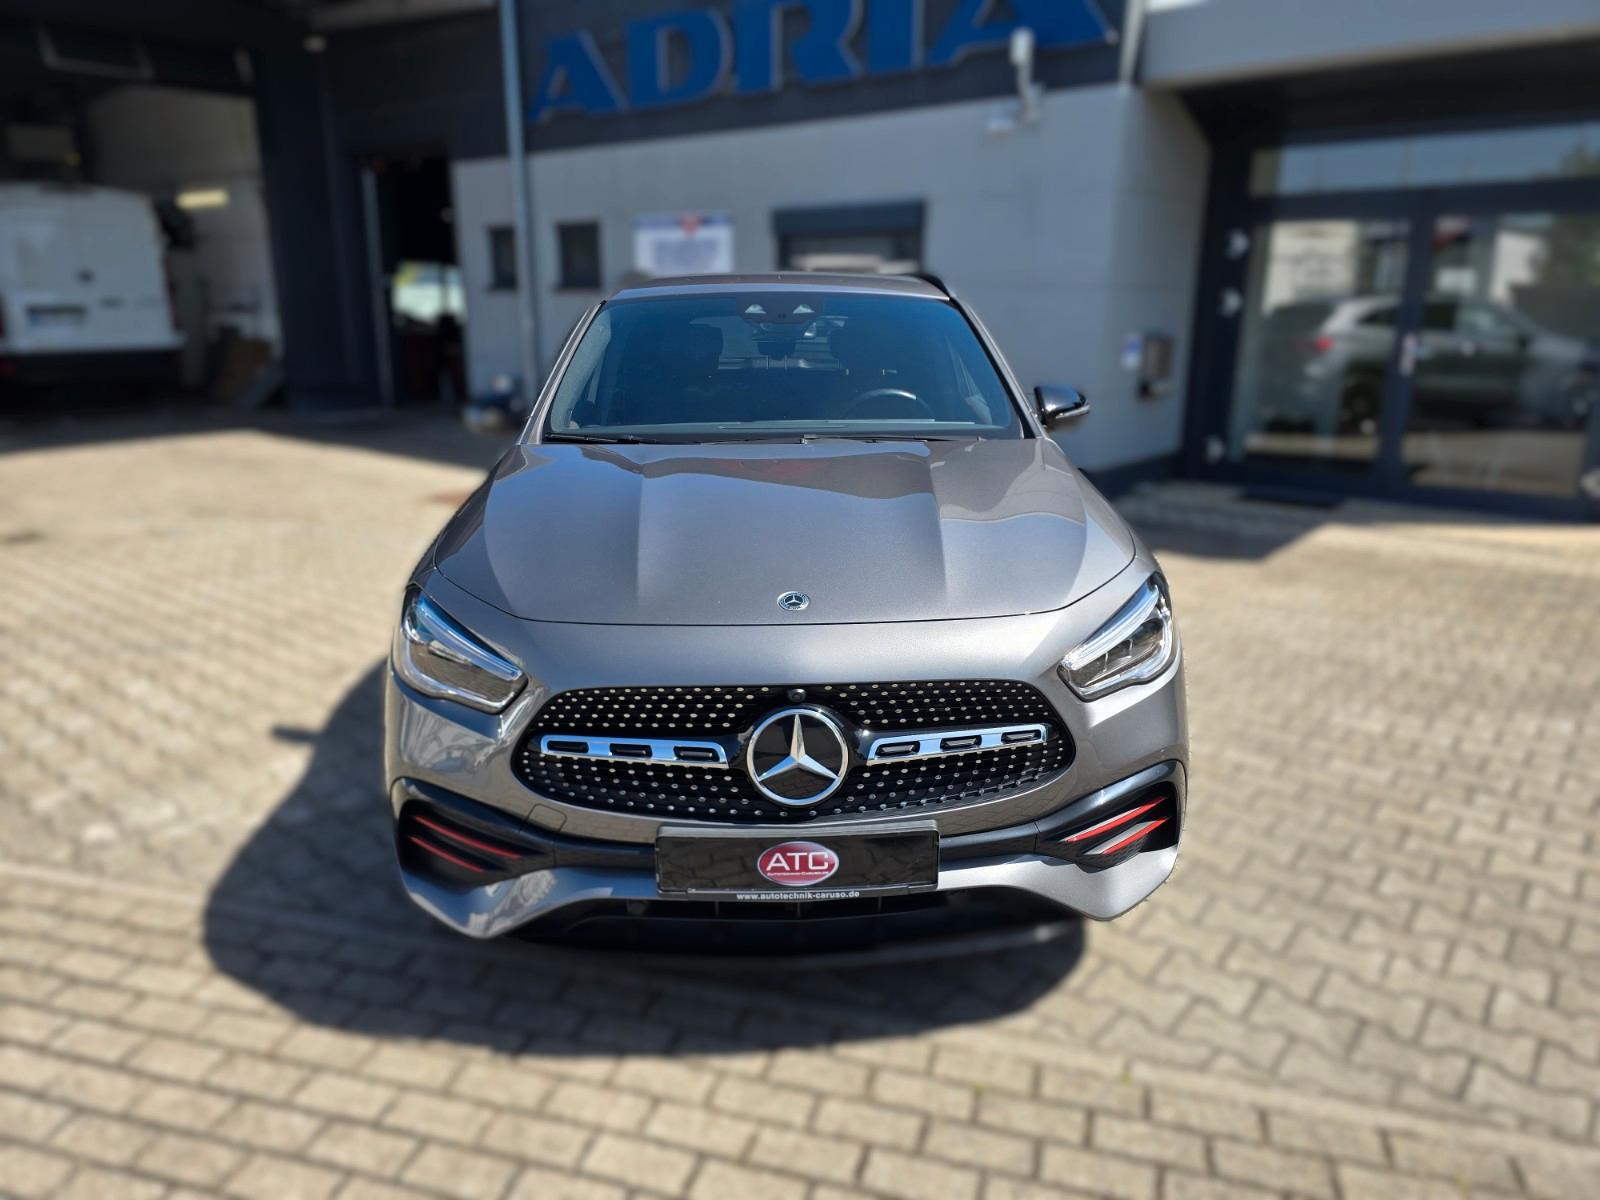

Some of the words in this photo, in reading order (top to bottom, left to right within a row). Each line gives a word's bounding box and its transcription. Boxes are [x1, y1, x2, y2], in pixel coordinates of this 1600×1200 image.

[529, 0, 1117, 122] ADRIA
[766, 852, 829, 870] ATC
[736, 891, 860, 900] www.autotechnik-caruso.de
